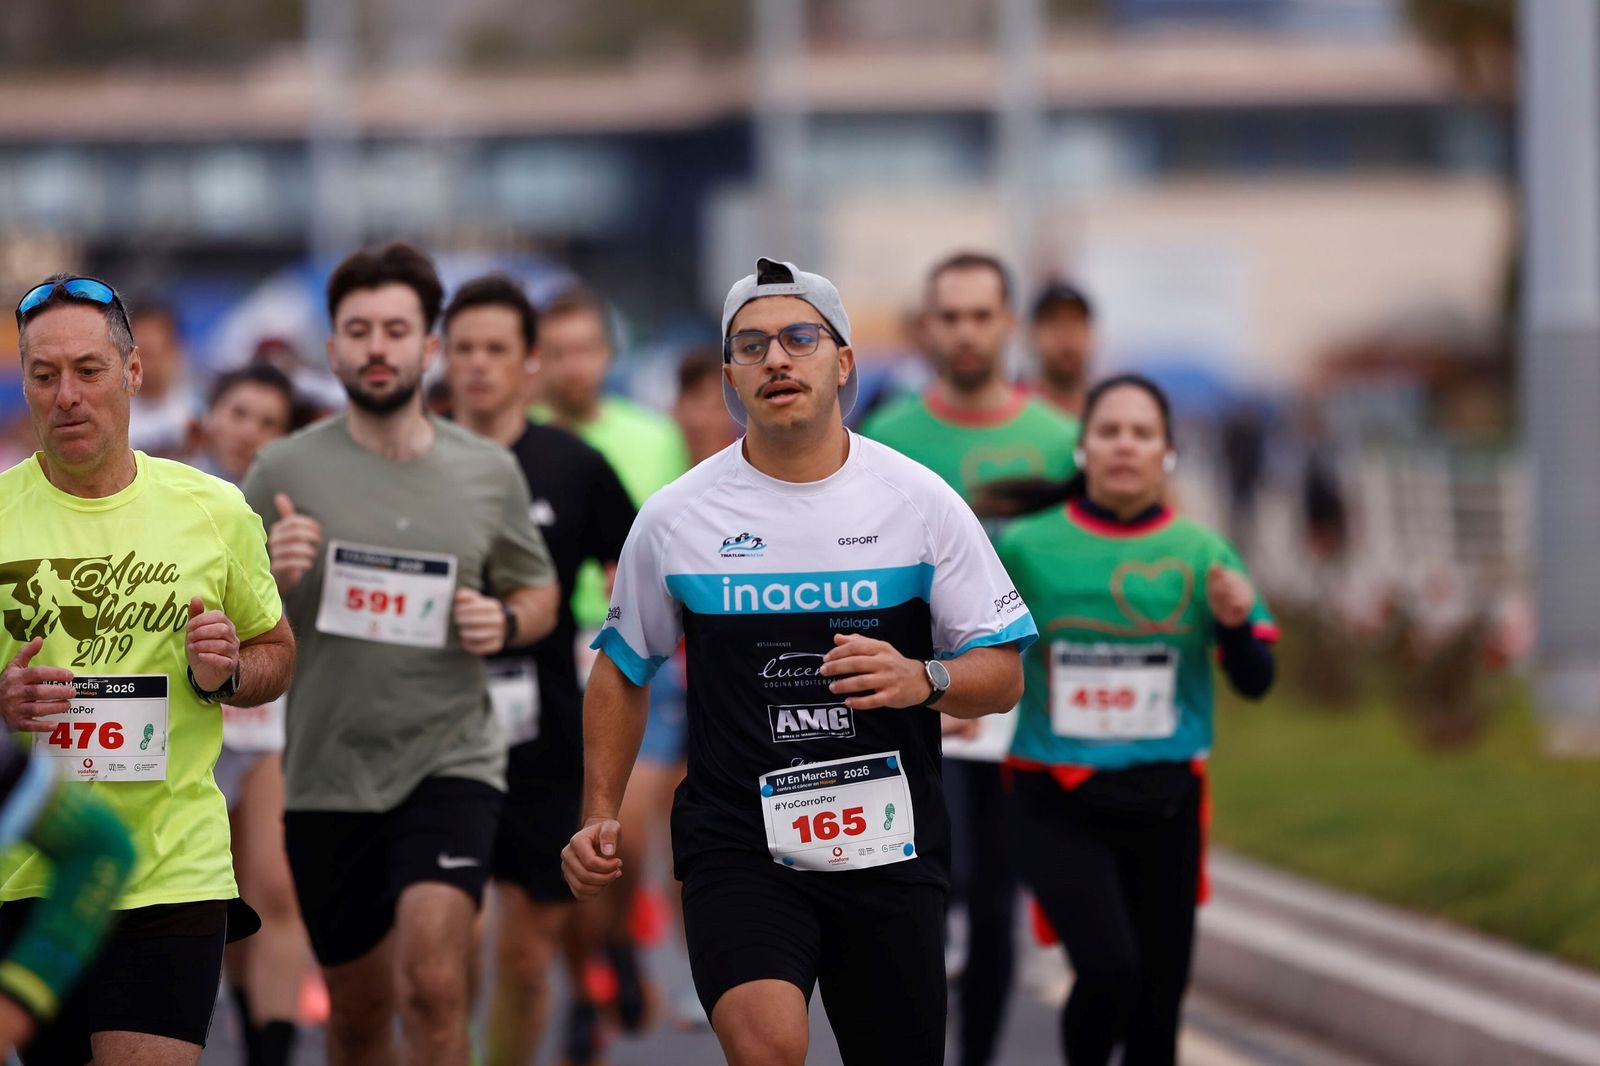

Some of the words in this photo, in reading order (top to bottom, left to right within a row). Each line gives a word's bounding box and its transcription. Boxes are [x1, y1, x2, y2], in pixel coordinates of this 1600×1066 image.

[838, 535, 879, 546] GSPORT
[80, 550, 180, 596] Agua
[346, 586, 406, 617] 591
[722, 576, 879, 611] inacua
[829, 617, 879, 630] Málaga
[70, 634, 134, 667] 2019
[105, 683, 135, 694] 2026
[777, 707, 849, 733] AMG
[49, 722, 124, 749] 476
[776, 777, 786, 786] IV
[787, 775, 799, 784] En
[801, 769, 837, 782] Marcha
[843, 765, 870, 779] 2026
[774, 796, 836, 811] #YoCorroPor
[792, 806, 867, 844] 165
